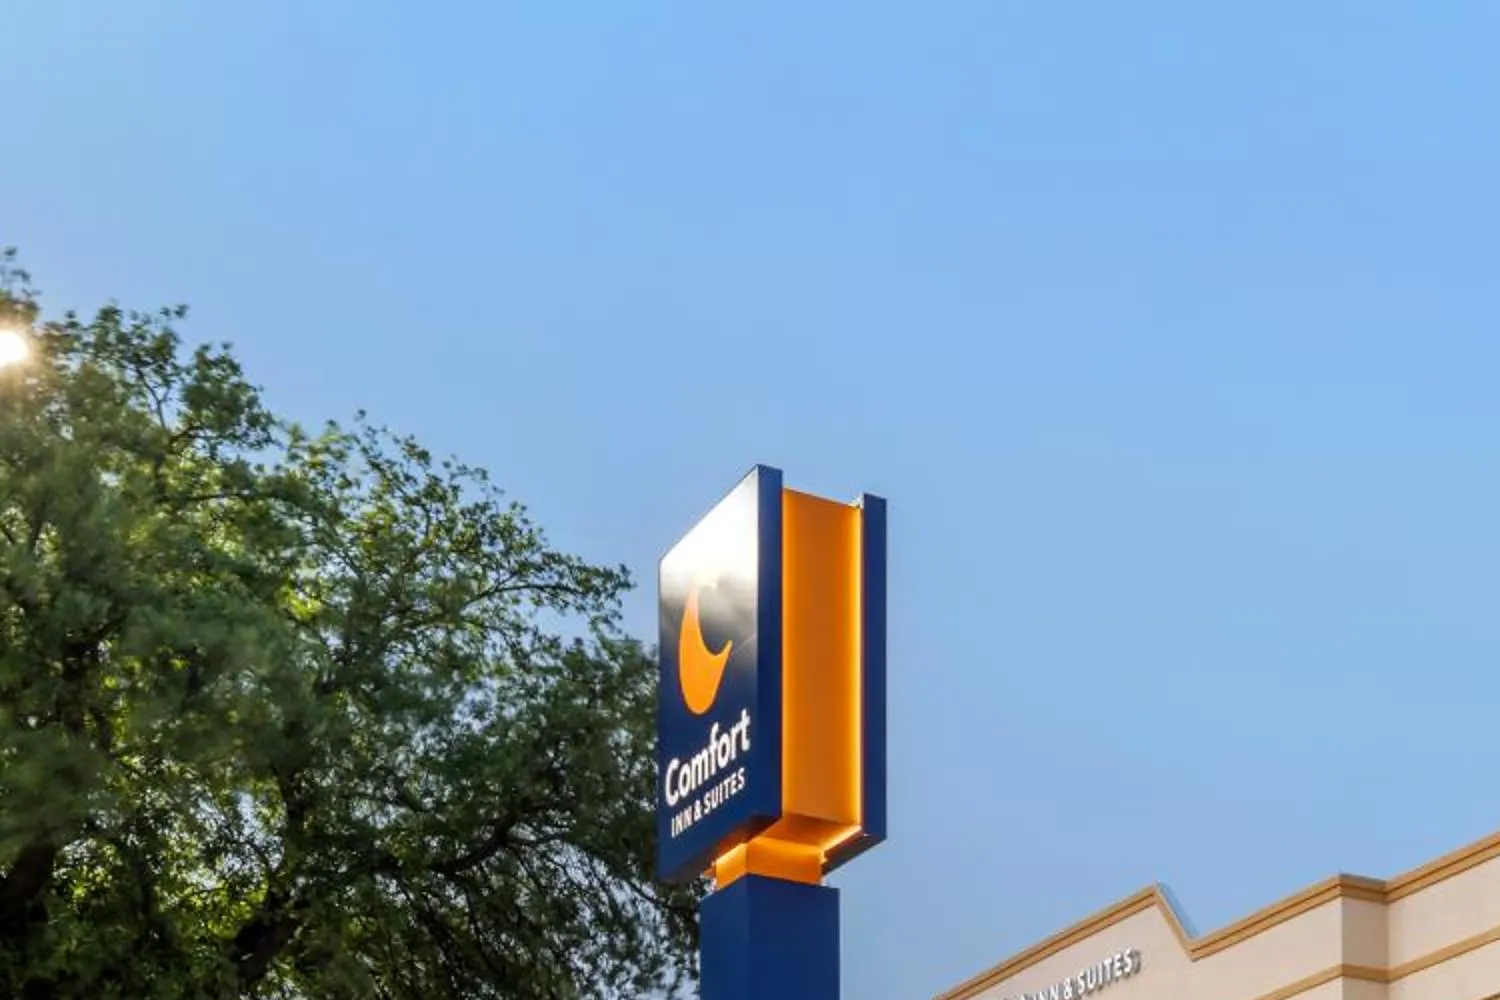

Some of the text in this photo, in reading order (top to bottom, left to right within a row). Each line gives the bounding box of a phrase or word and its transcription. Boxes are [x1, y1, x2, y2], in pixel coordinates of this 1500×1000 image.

[665, 708, 751, 807] Comfort
[671, 767, 745, 838] INN & SUITES
[1063, 978, 1074, 1000] &
[1077, 948, 1135, 994] SUITES
